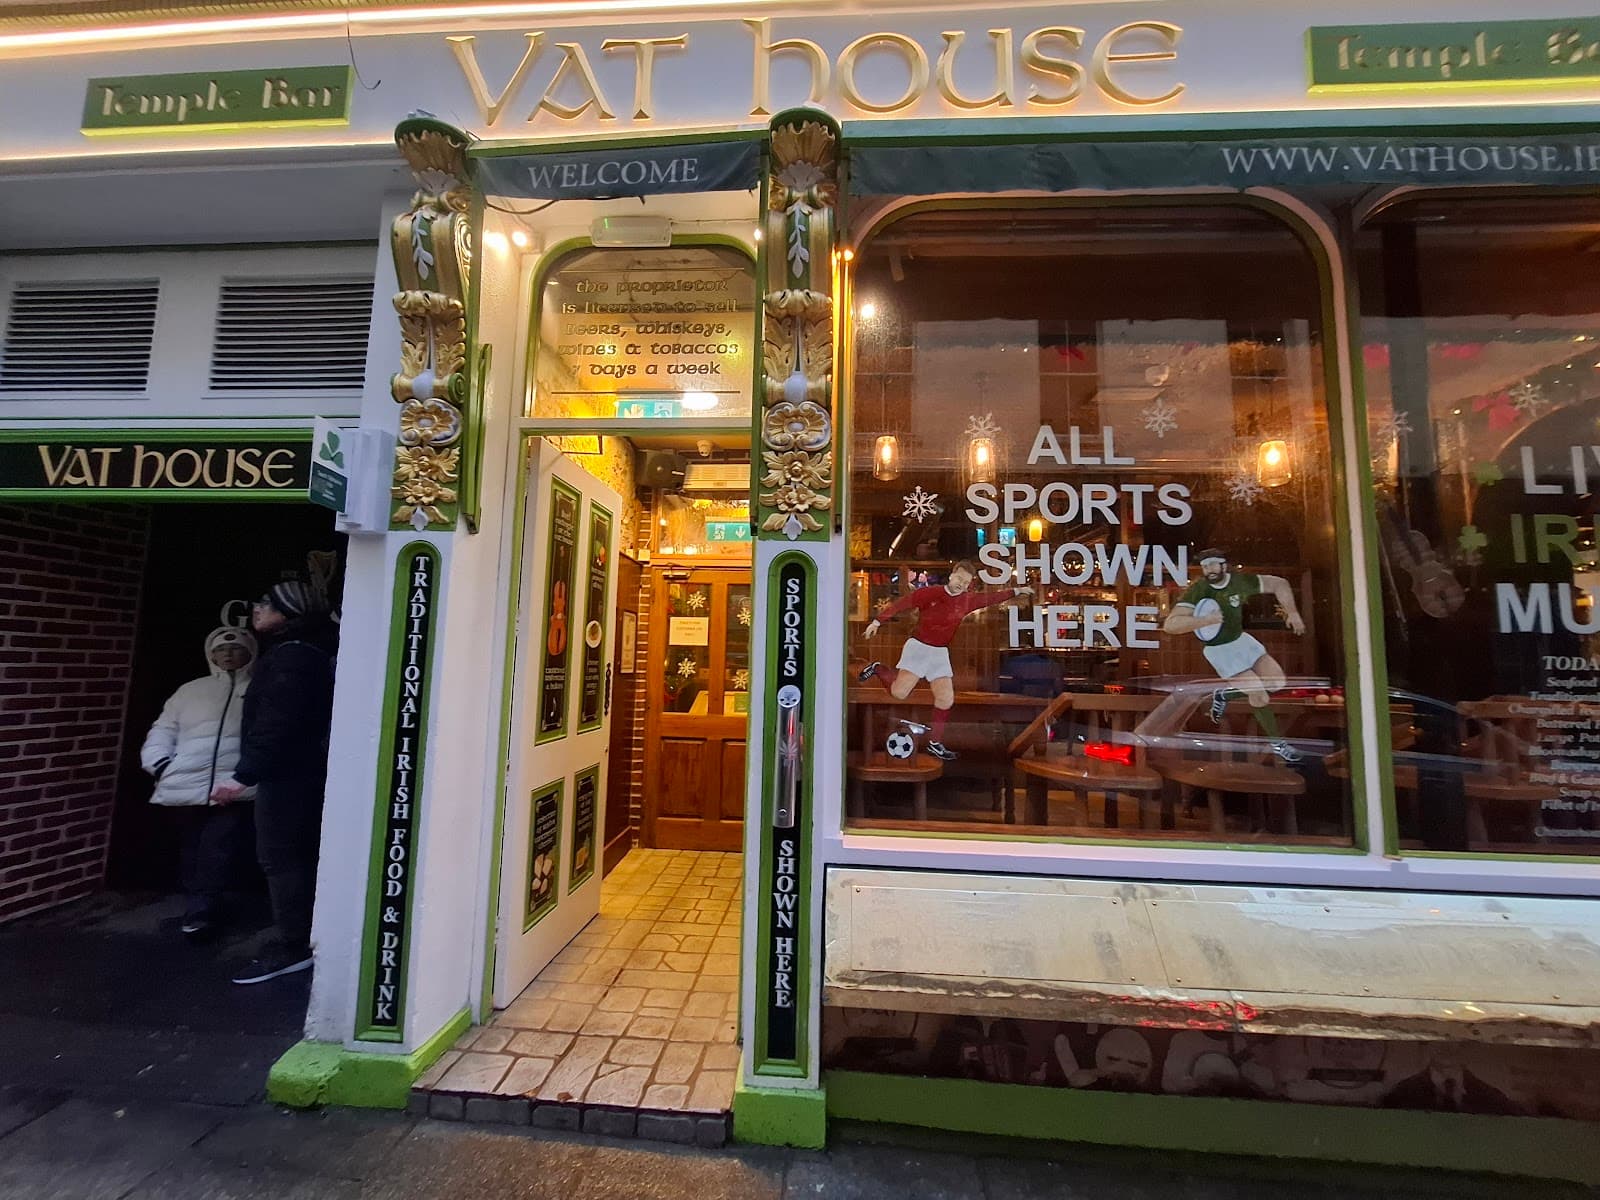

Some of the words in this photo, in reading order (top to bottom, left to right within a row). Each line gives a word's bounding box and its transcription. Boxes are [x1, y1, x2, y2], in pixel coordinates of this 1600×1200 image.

[261, 76, 341, 110] Bar
[445, 31, 689, 126] VAT
[528, 156, 700, 192] WELCOME
[38, 445, 123, 487] VAT
[1026, 425, 1135, 465] ALL
[1520, 446, 1600, 495] LI
[965, 481, 1193, 526] SPORTS
[977, 542, 1188, 587] SHOWN
[399, 555, 430, 729] TRADITIONAL
[783, 577, 801, 678] SPORTS
[1007, 604, 1161, 650] HERE
[391, 736, 413, 820] IRISH
[385, 828, 407, 897] FOOD
[772, 839, 799, 930] SHOWN
[383, 905, 401, 924] &
[375, 931, 398, 1021] DRINK
[774, 936, 795, 1009] HERE
